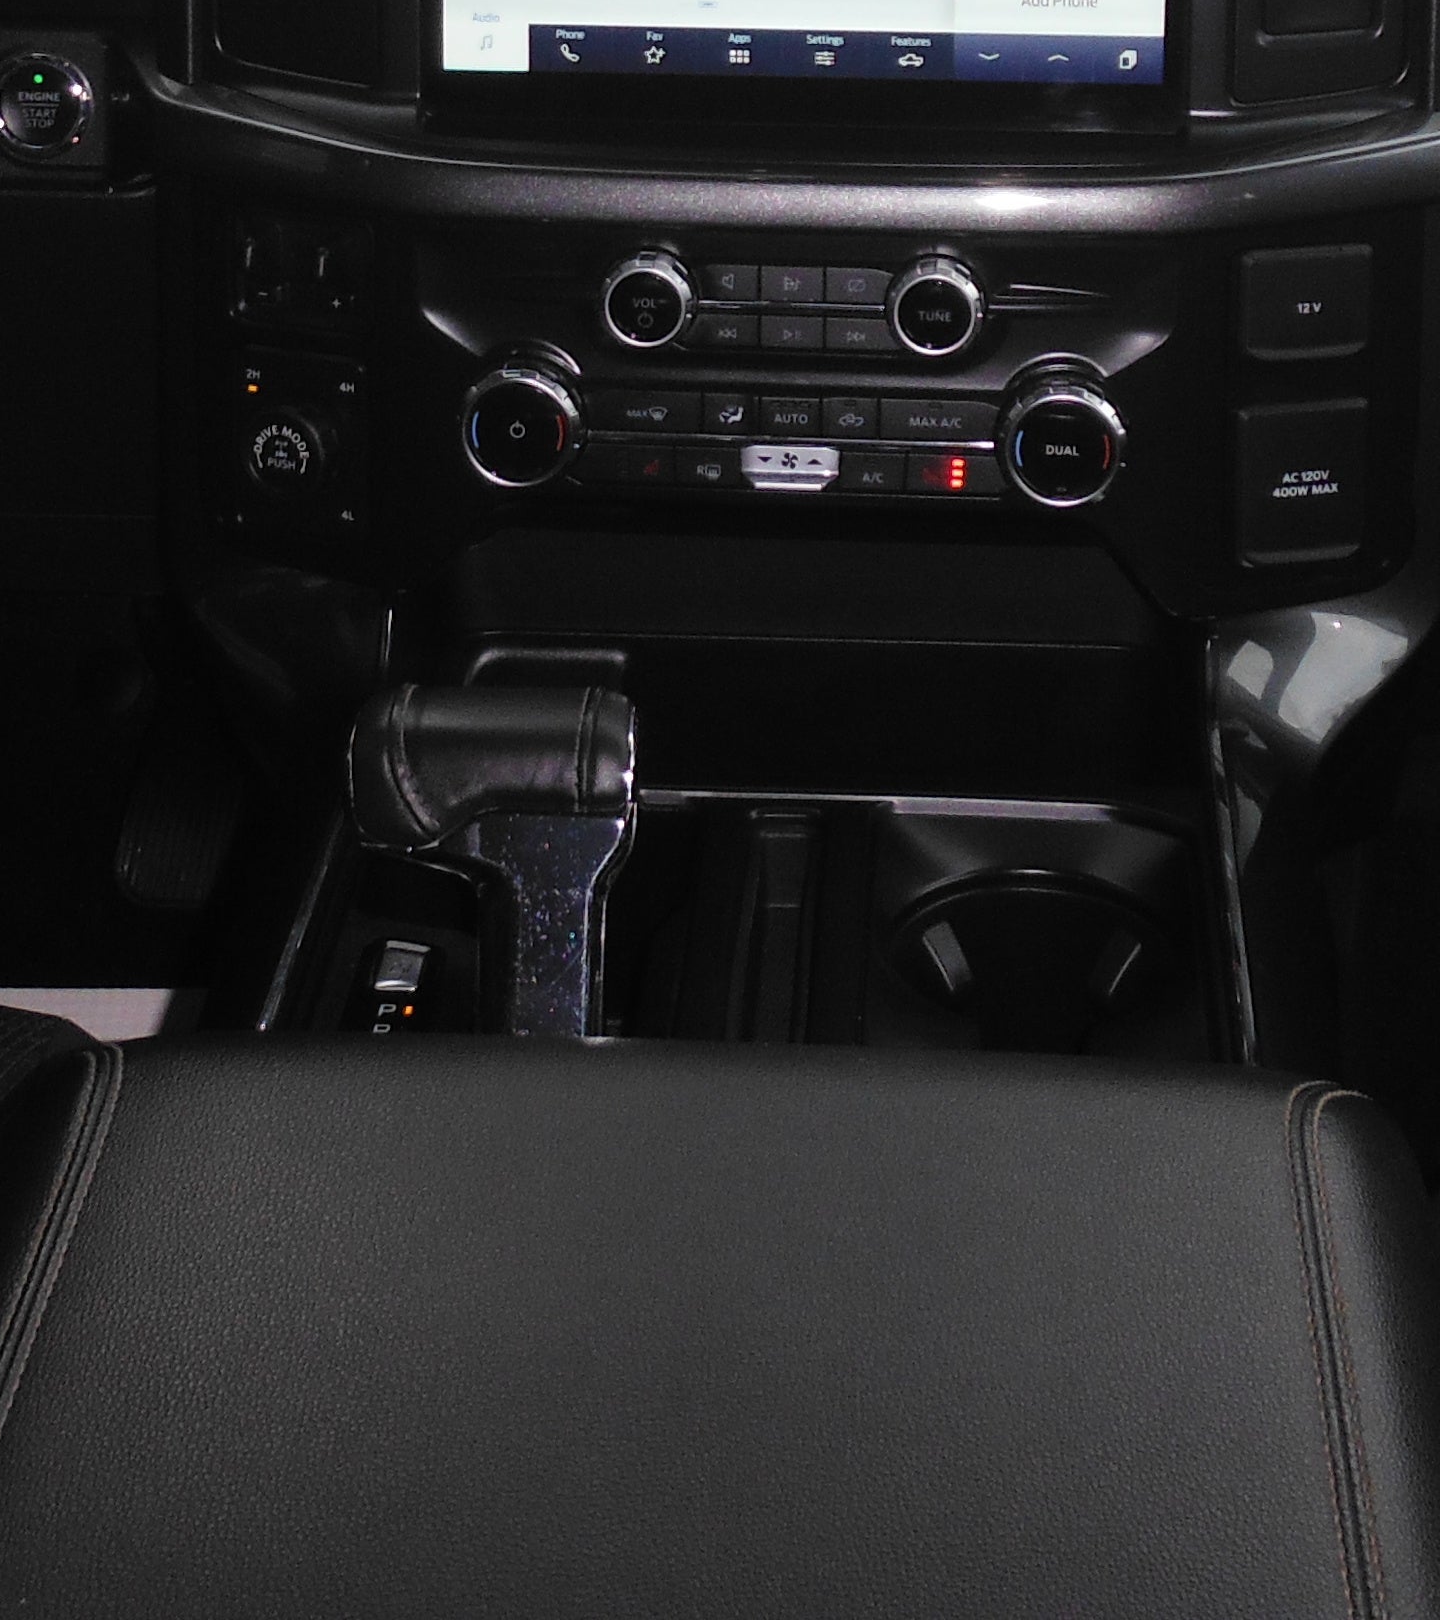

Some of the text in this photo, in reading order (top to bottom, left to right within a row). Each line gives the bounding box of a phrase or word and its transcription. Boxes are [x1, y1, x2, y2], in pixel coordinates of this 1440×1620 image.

[471, 11, 501, 24] Audio
[555, 28, 586, 41] Phone
[645, 30, 664, 42] Fav
[727, 32, 752, 45] Apps
[805, 33, 845, 48] Settings
[890, 35, 932, 48] Features
[17, 90, 61, 102] ENGINE
[21, 107, 58, 119] START
[24, 118, 56, 129] STOP
[632, 297, 657, 310] VOL
[1296, 301, 1323, 315] 12 V
[916, 310, 953, 324] TUNE
[245, 367, 261, 380] 2H
[338, 381, 356, 394] 4H
[773, 412, 809, 426] AUTO
[908, 415, 963, 430] MAX A/C
[1044, 443, 1081, 457] DUAL
[266, 456, 297, 471] PUSH
[861, 471, 885, 485] A/C
[1281, 469, 1331, 484] AC 120V
[1271, 481, 1340, 499] 400W MAX
[340, 509, 356, 522] 4L
[377, 1003, 398, 1018] P
